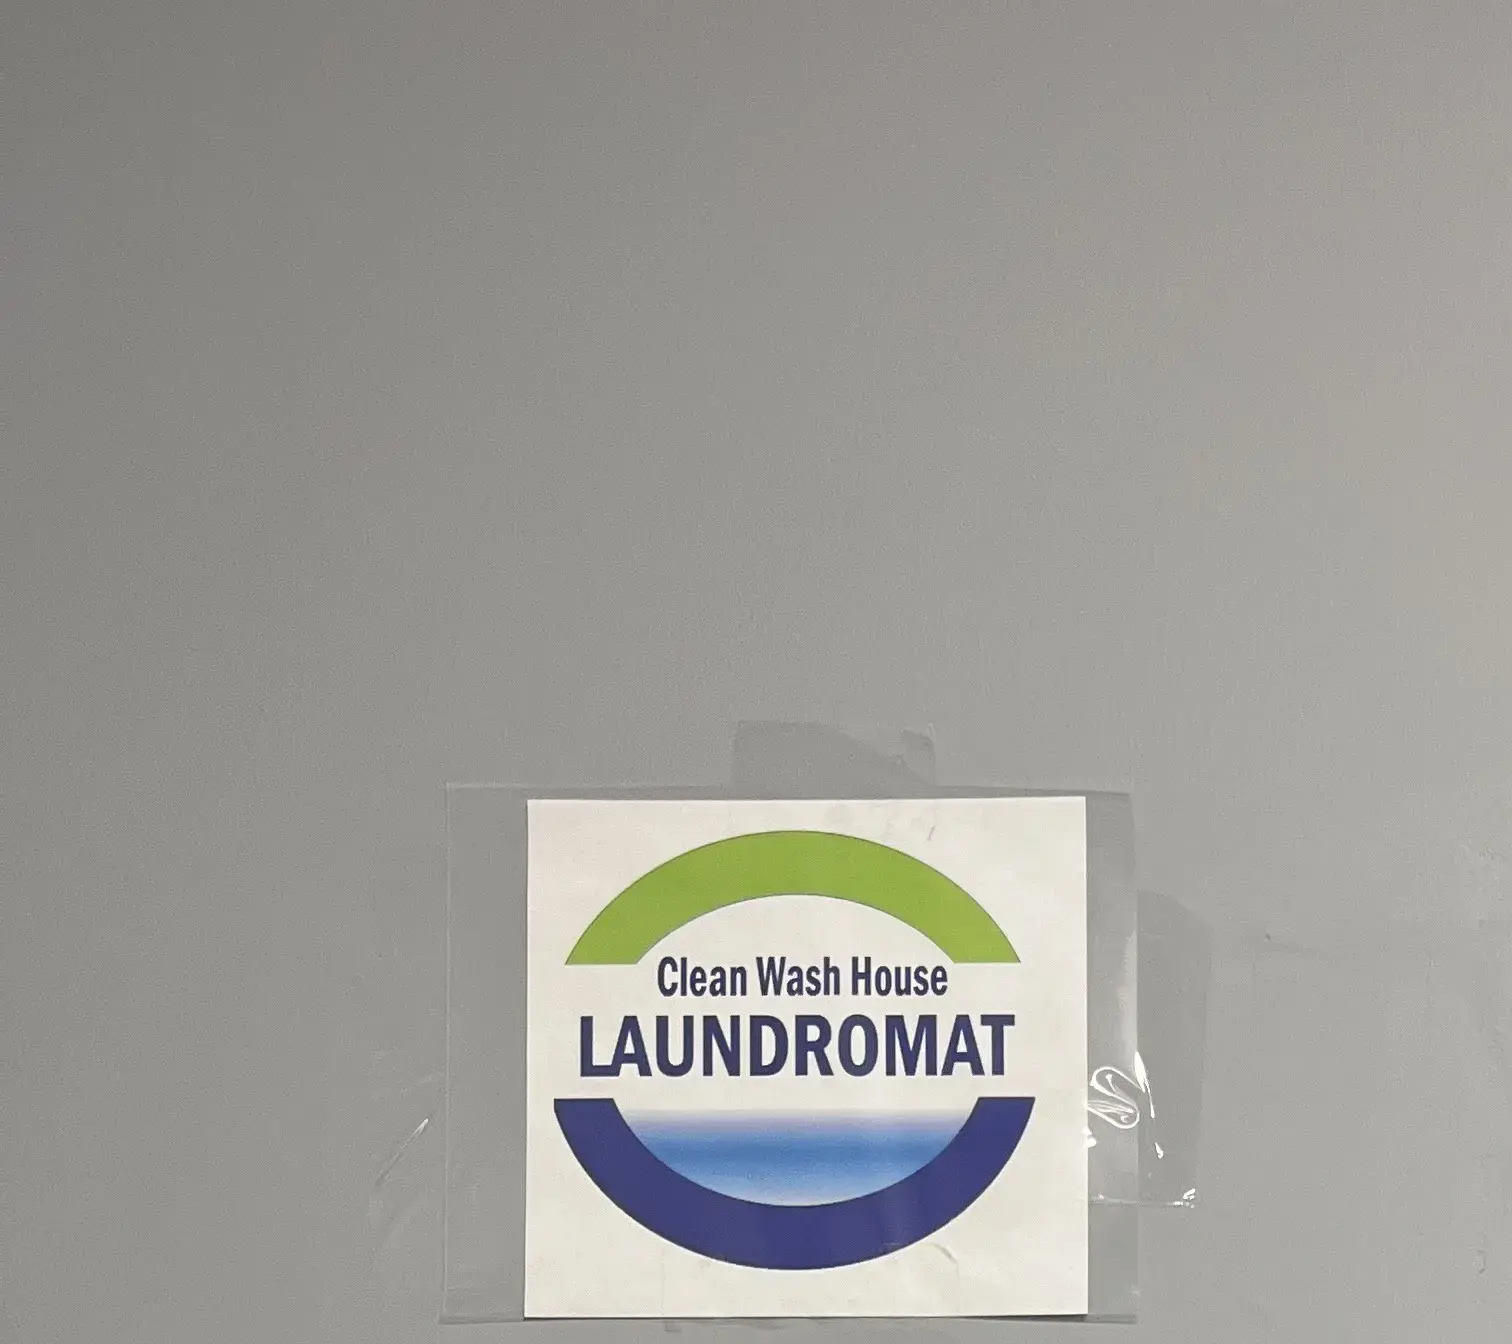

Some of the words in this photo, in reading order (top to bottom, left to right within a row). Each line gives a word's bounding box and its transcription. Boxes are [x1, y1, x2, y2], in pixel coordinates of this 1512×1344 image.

[657, 956, 747, 996] Clean
[756, 956, 840, 995] Wash
[851, 956, 948, 995] House
[580, 1013, 1015, 1078] LAUNDROMAT
